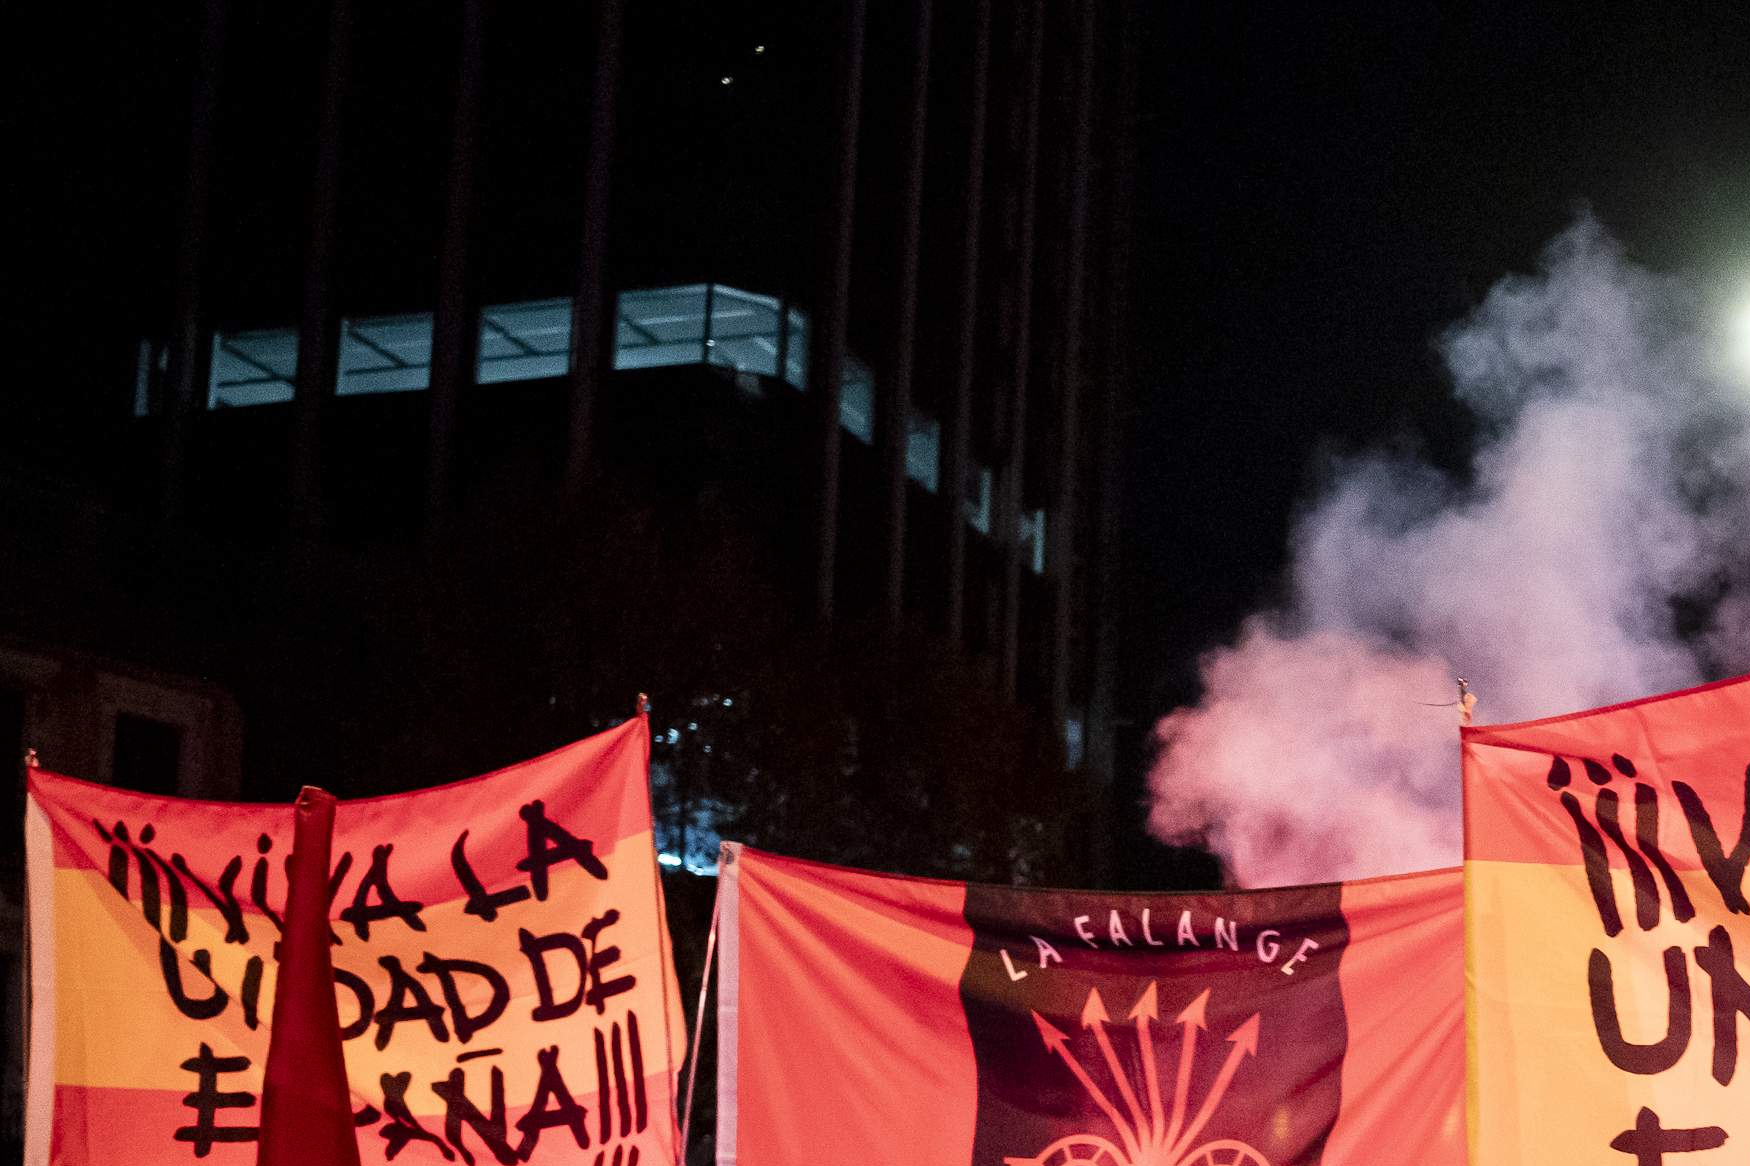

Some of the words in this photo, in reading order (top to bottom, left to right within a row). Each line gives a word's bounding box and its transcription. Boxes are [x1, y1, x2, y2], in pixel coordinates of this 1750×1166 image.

[451, 800, 608, 921] LA
[520, 909, 636, 1022] DE
[1001, 937, 1062, 982] LA
[1075, 909, 1319, 976] FALANGE
